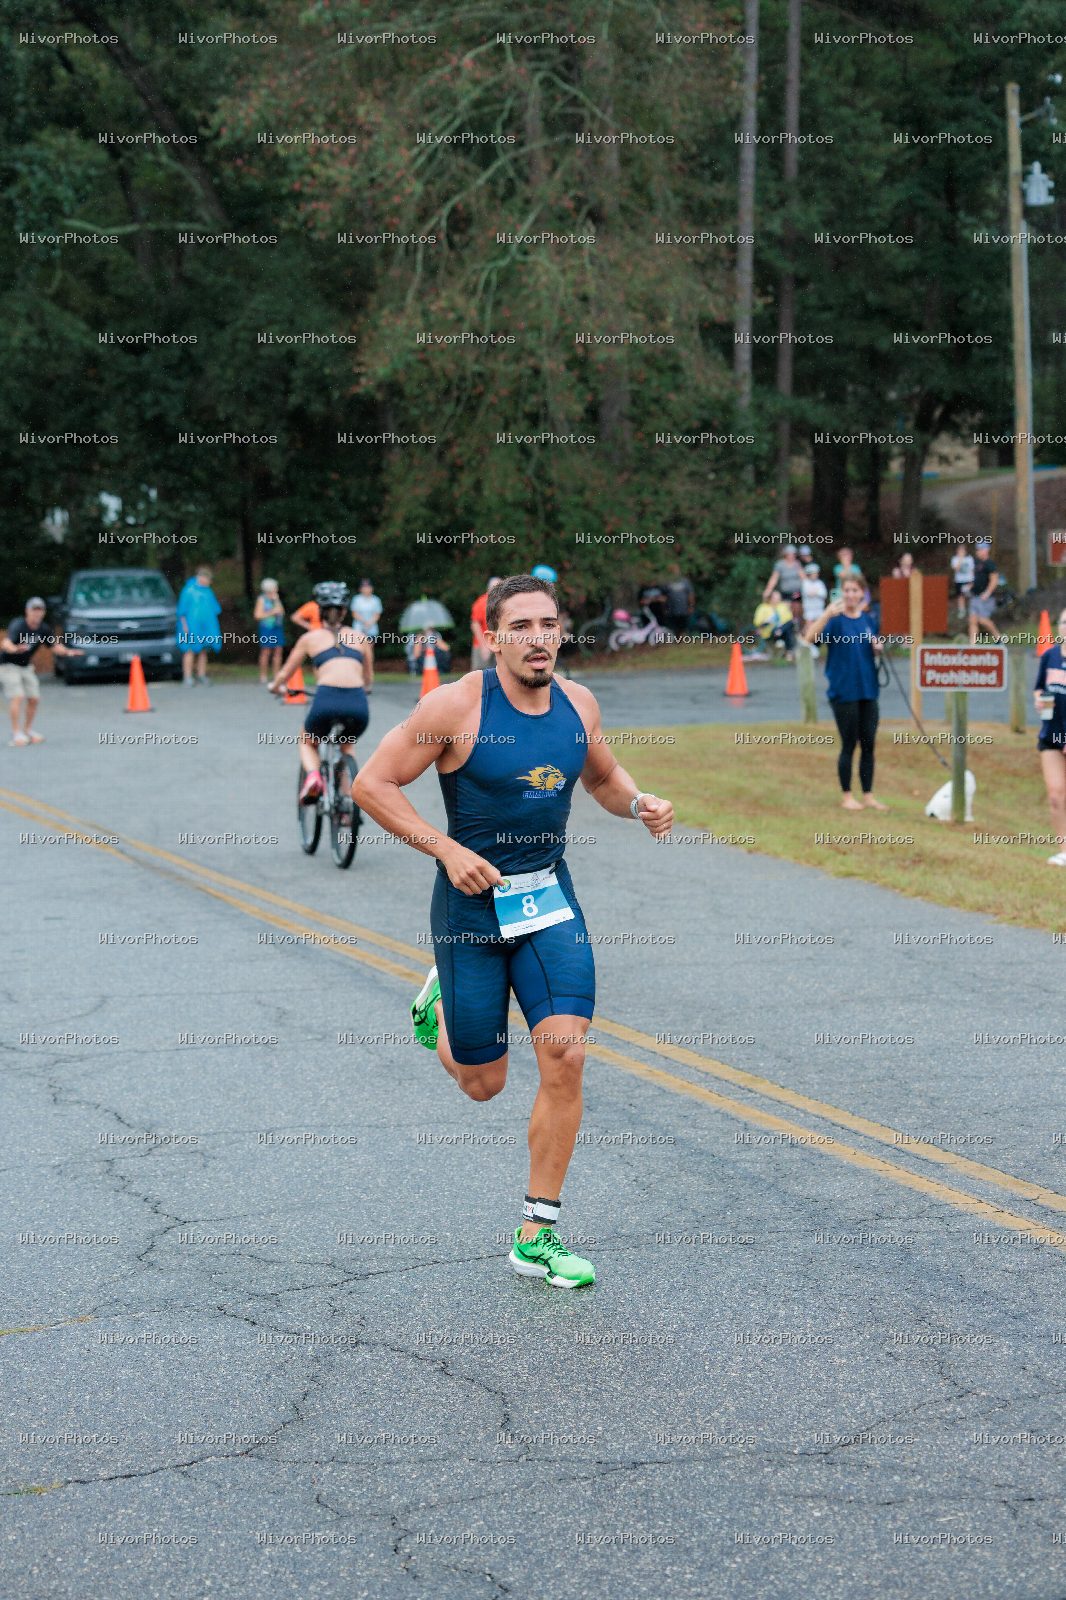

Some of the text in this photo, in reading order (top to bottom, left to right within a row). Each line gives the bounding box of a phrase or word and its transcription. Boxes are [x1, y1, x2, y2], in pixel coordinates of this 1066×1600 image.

[924, 651, 999, 666] Intoxicants
[926, 669, 997, 684] Prohibited
[522, 895, 538, 917] 8
